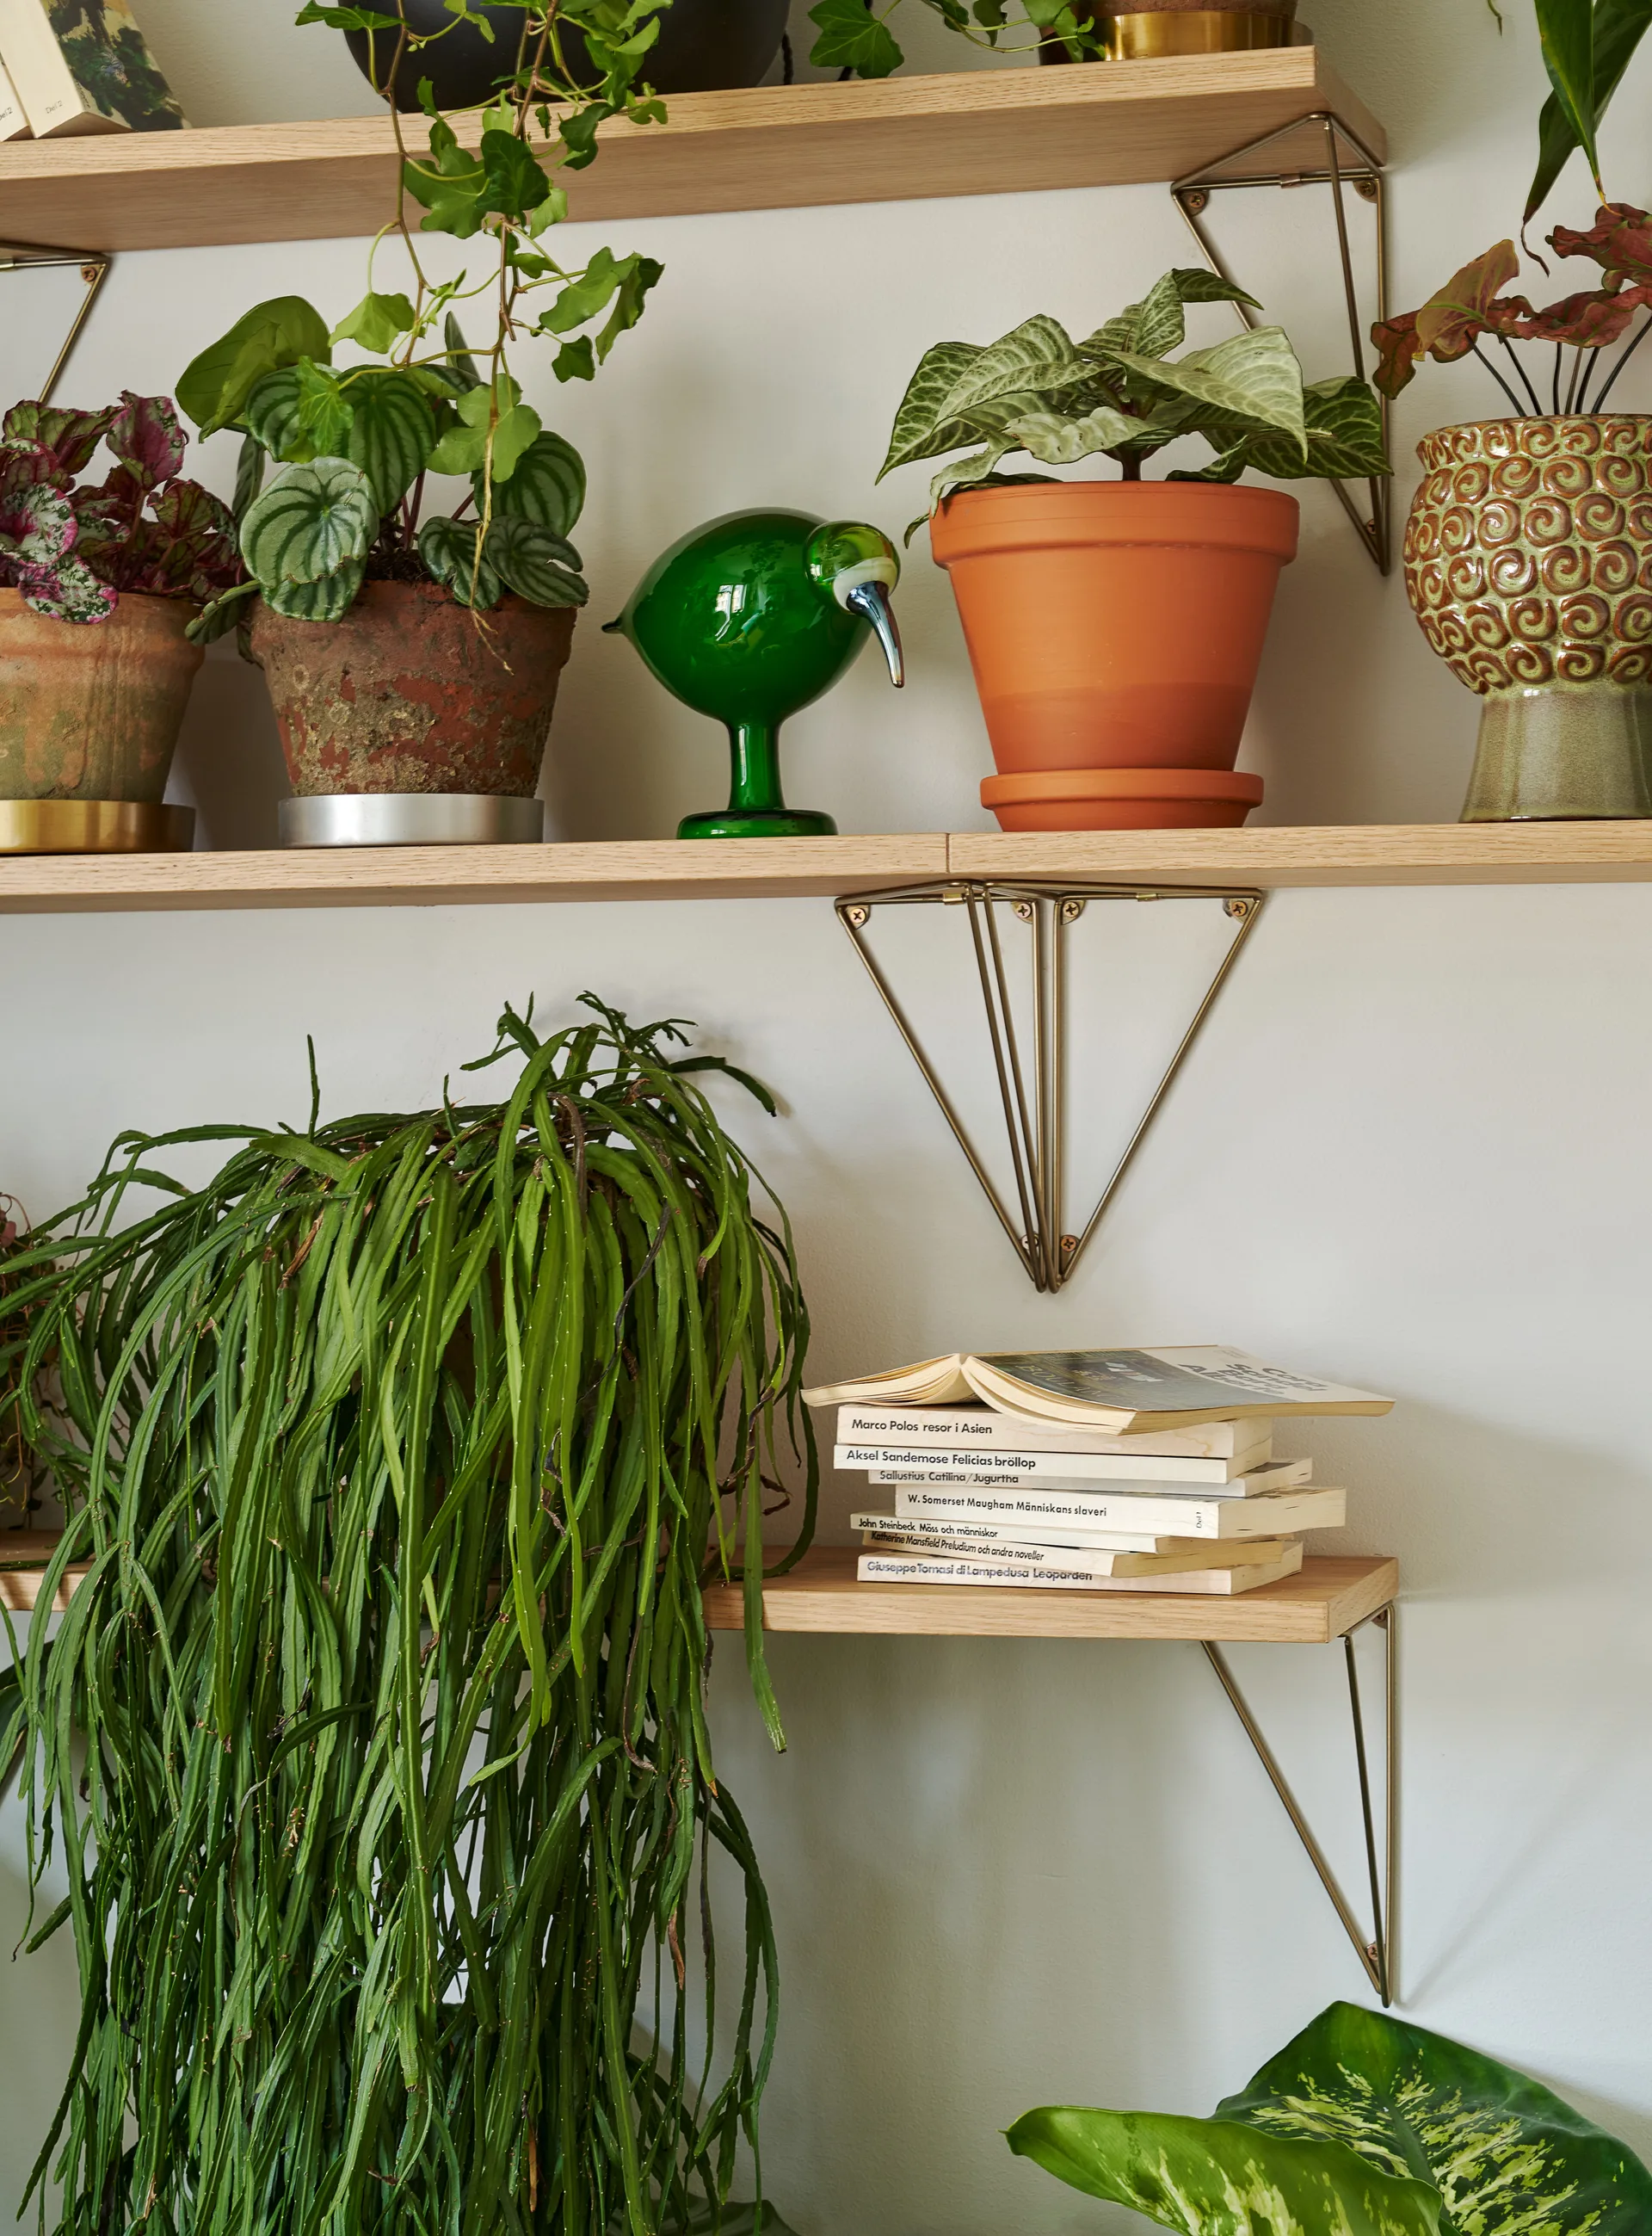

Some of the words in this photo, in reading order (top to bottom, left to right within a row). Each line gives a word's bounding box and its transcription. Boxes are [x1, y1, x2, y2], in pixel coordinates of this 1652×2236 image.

[852, 1419, 887, 1430] Marco
[890, 1421, 918, 1431] Polos
[922, 1424, 952, 1432] resor
[955, 1423, 959, 1432] i
[961, 1424, 992, 1434] Asien
[847, 1449, 878, 1461] Aksel
[882, 1451, 948, 1464] Sandemose
[952, 1455, 992, 1466] Felicias
[995, 1455, 1036, 1470] bröllop
[879, 1471, 925, 1481] Sallustius
[908, 1494, 921, 1503] W.
[922, 1495, 965, 1506] Somerset
[967, 1498, 1014, 1510] Maugham
[1016, 1501, 1072, 1514] Människans
[1074, 1505, 1107, 1516] slaveri
[859, 1518, 877, 1529] John
[879, 1520, 915, 1531] Steinbeck
[919, 1523, 939, 1533] Möss
[940, 1524, 955, 1535] och
[957, 1526, 998, 1538] människor
[871, 1531, 905, 1545] Katherine
[906, 1535, 940, 1548] Mansfield
[940, 1539, 977, 1553] Preludium
[977, 1544, 990, 1554] och
[991, 1547, 1014, 1558] andra
[1014, 1550, 1045, 1561] noveller
[867, 1561, 917, 1575] Giuseppe
[917, 1563, 953, 1575] Tomasi
[956, 1565, 966, 1575] di
[966, 1566, 1029, 1578] Lampedusa
